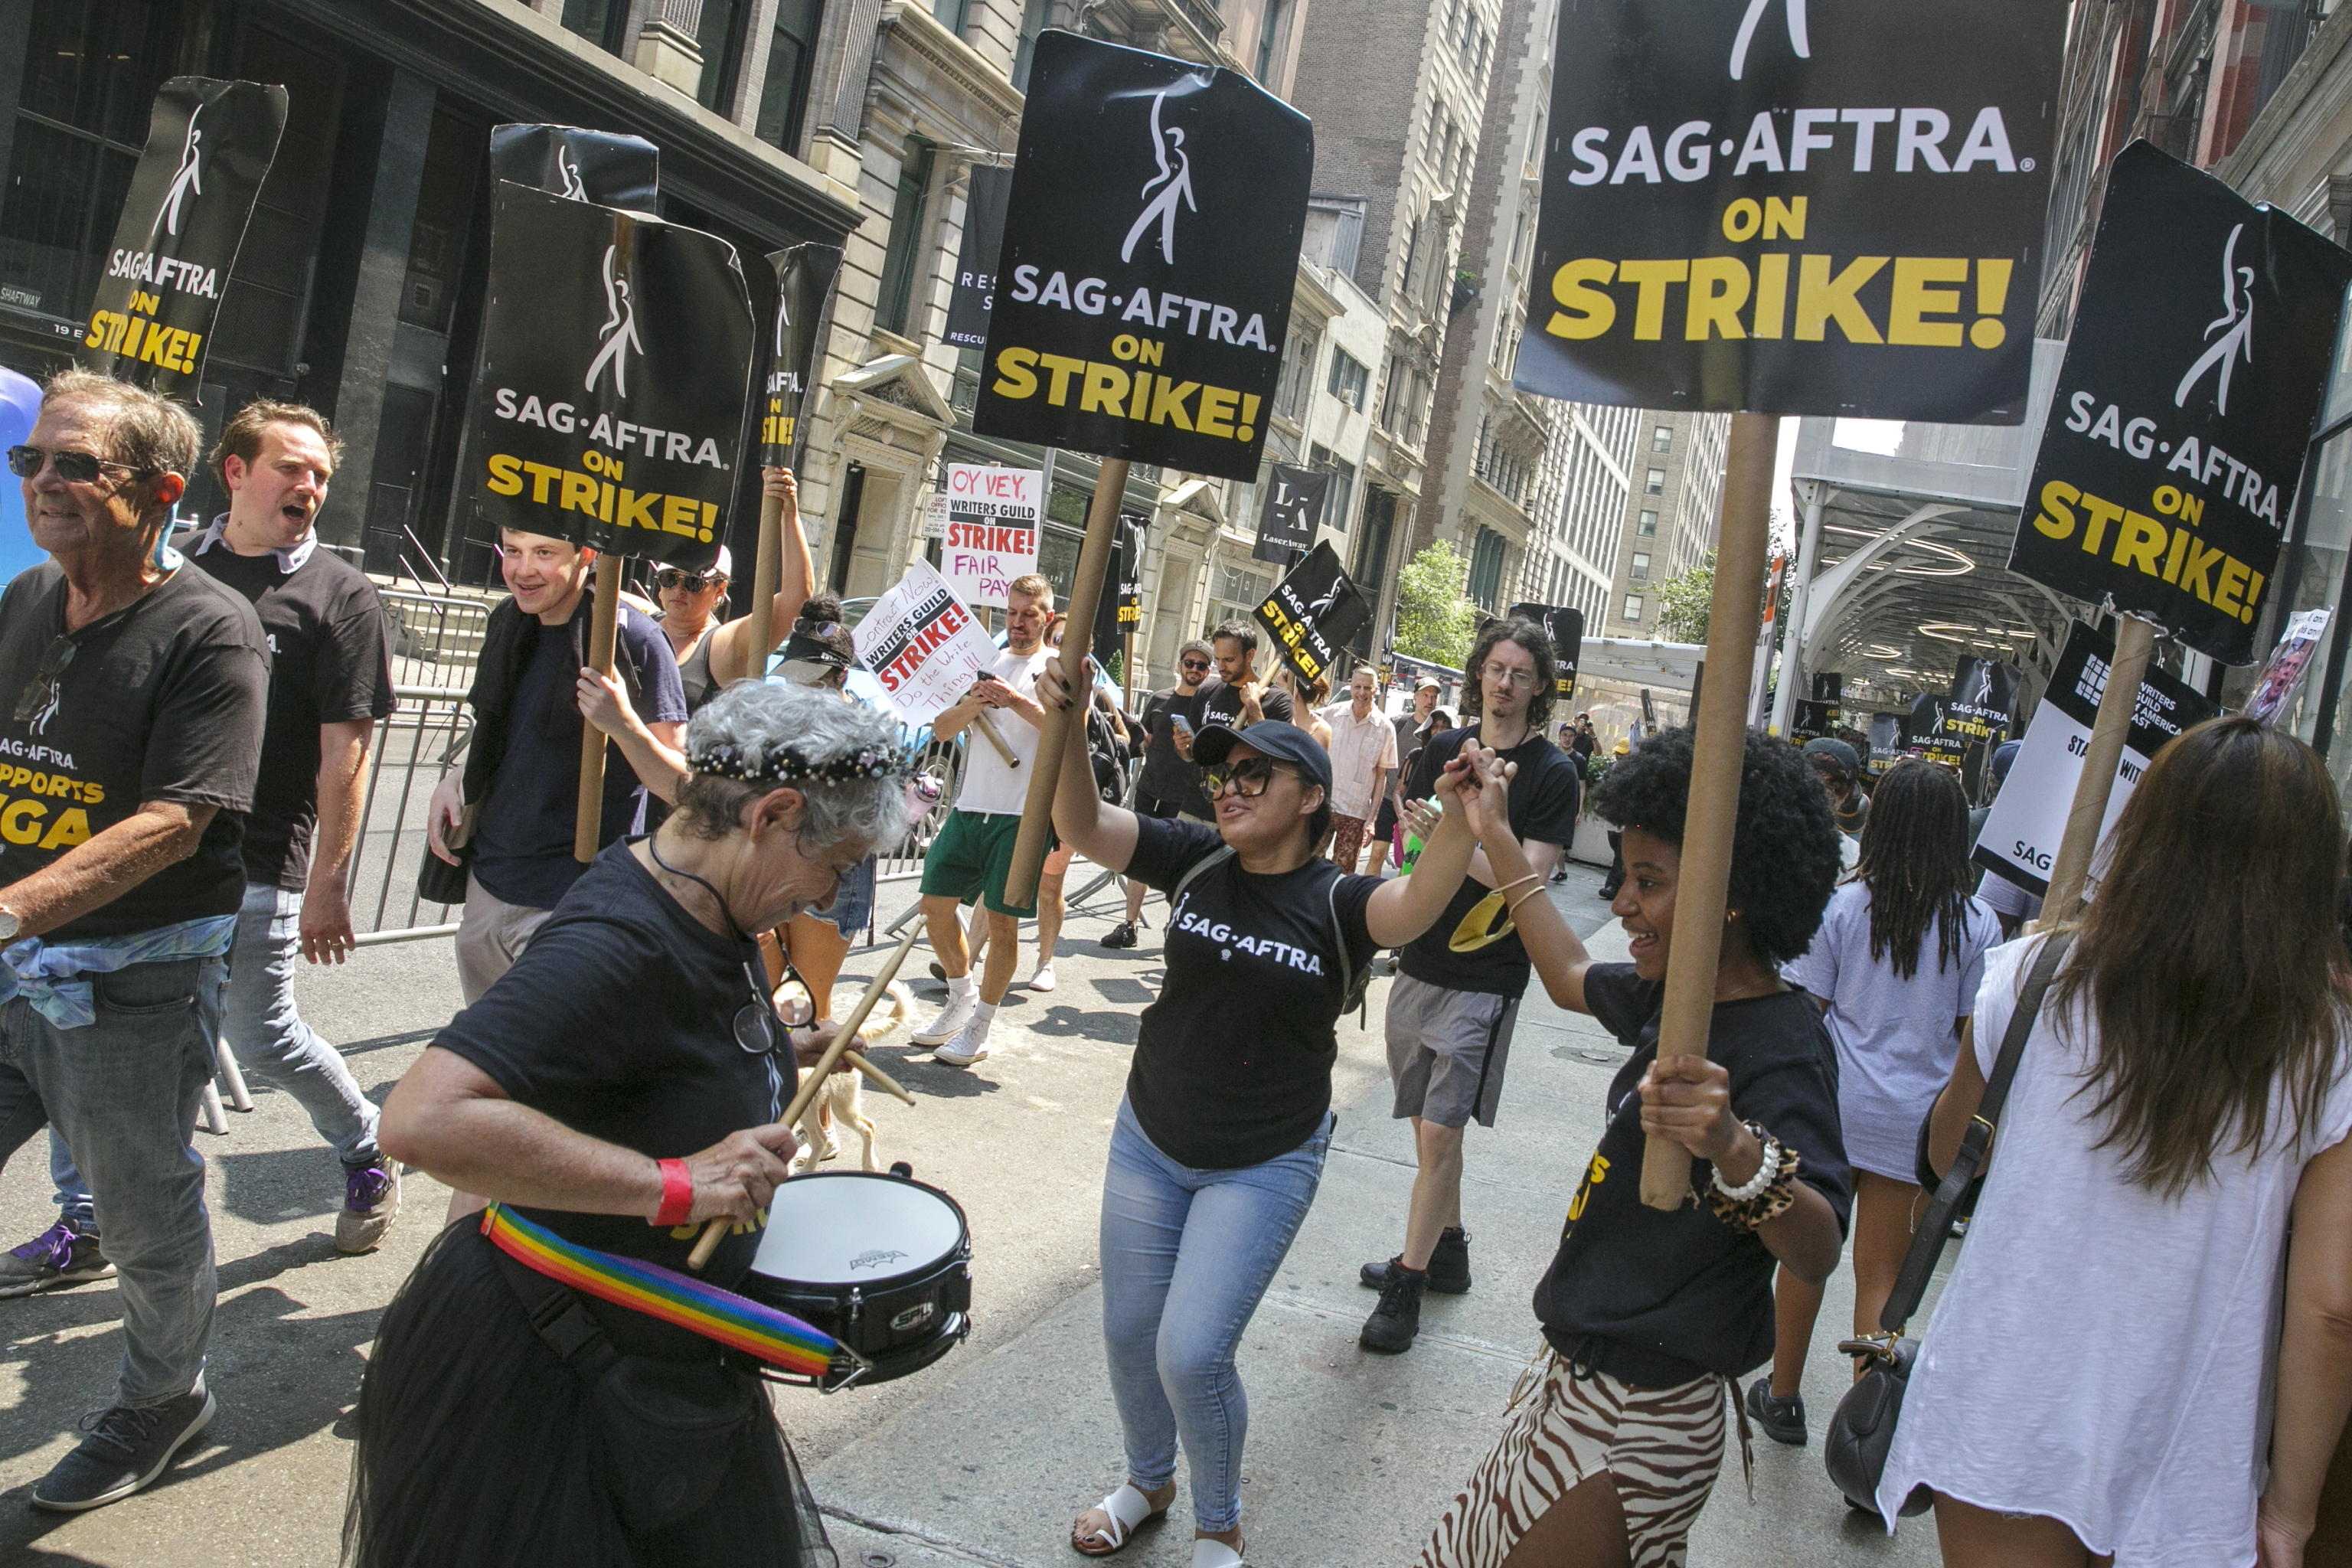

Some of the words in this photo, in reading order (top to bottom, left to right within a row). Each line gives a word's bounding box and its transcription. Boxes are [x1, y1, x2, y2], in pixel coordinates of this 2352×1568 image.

[1722, 195, 1808, 243] ON
[1, 287, 41, 308] SHAFTWAY
[129, 289, 160, 316] ON
[1545, 253, 2014, 350] STRIKE!
[54, 324, 69, 335] 19
[85, 309, 202, 374] STRIKE!
[1112, 334, 1165, 367] ON
[992, 347, 1262, 443] STRIKE!
[583, 450, 623, 482] ON
[953, 470, 981, 495] OY
[487, 454, 719, 544] STRIKE!
[951, 499, 996, 515] WRITERS
[1000, 505, 1035, 518] GUILD
[2152, 485, 2205, 527] ON
[984, 516, 995, 526] ON
[948, 522, 1035, 555] STRIKE!
[1263, 534, 1308, 550] LaserAway
[2033, 481, 2265, 625] STRIKE!
[954, 555, 1004, 577] FAIR
[900, 566, 939, 605] Now!
[979, 578, 1013, 598] PAY
[865, 617, 912, 665] WRITERS
[912, 588, 947, 620] GUILD
[906, 626, 920, 641] ON
[1263, 600, 1320, 678] STRIKE!
[880, 603, 969, 692] STRIKE!
[896, 691, 923, 707] Do
[921, 668, 939, 686] the
[1945, 719, 2007, 742] STRIK!
[2131, 714, 2151, 729] AST
[1923, 752, 1961, 766] TRIKE!
[0, 793, 91, 850] GA
